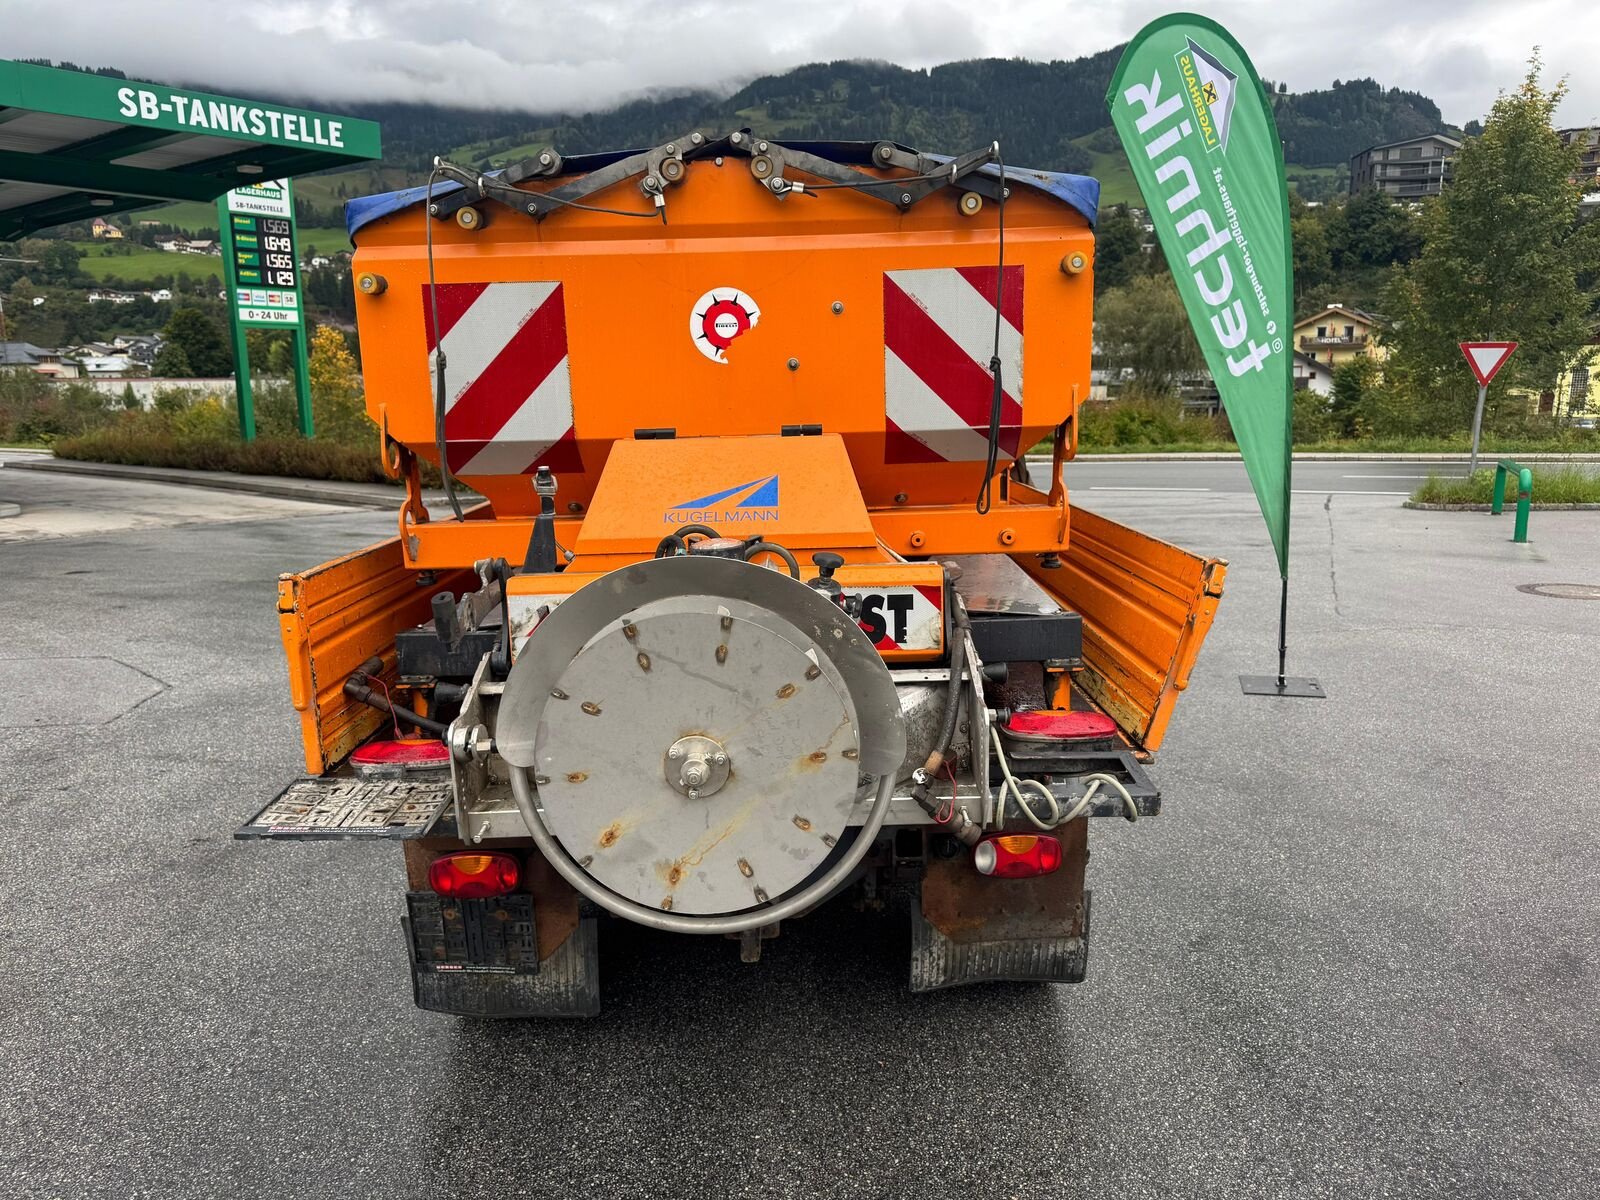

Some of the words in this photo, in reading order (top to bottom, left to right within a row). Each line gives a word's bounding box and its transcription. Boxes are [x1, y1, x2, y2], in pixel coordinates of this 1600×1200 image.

[117, 87, 344, 148] SB-TANKSTELLE
[236, 187, 281, 198] LAGERHAUS
[235, 202, 283, 212] SB-TANKSTELLE
[263, 218, 289, 235] 1.569
[264, 236, 291, 252] 1.649
[266, 253, 292, 269] 1.565
[248, 310, 255, 319] 0
[260, 311, 272, 319] 24
[273, 312, 288, 320] Uhr
[663, 510, 779, 524] KUGELMANN
